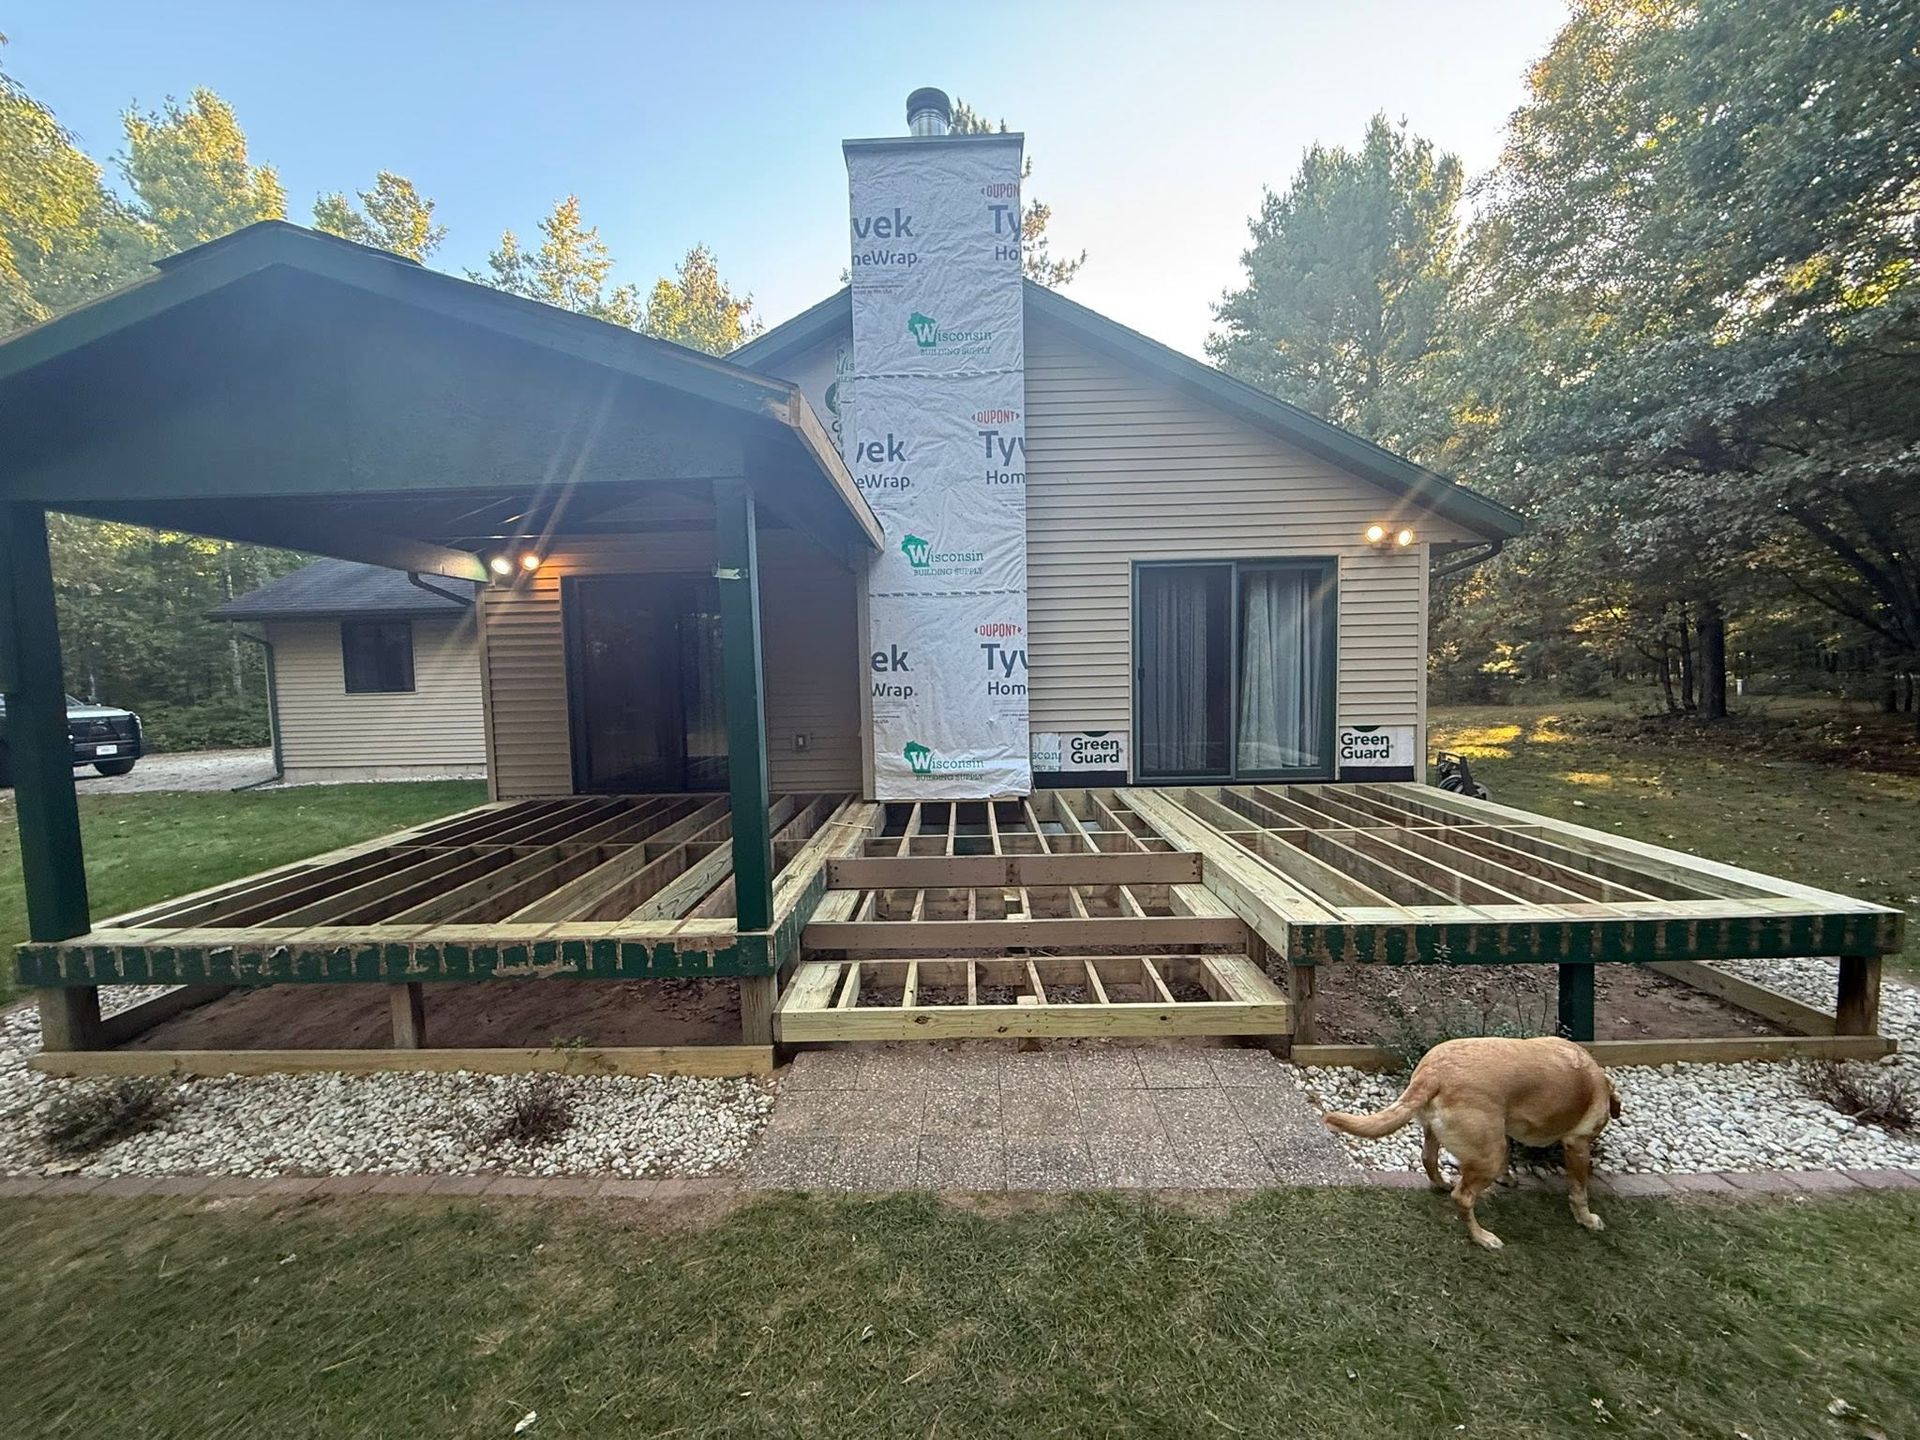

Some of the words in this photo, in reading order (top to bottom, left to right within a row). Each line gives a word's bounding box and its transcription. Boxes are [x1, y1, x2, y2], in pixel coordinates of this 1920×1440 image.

[987, 204, 1020, 242] Ty
[914, 322, 992, 343] Wisconsin
[977, 410, 1015, 424] DUPONT
[856, 474, 911, 492] eWrap
[908, 543, 984, 565] Wisconsin
[914, 568, 953, 576] BUILDING
[954, 567, 983, 575] SUPPLY
[980, 623, 1017, 637] DUPONT
[871, 644, 910, 672] ek
[1070, 737, 1119, 750] Green
[1341, 732, 1390, 746] Green
[1070, 750, 1120, 764] Guard
[1341, 746, 1390, 760] Guard
[910, 751, 984, 770] Wisconsin
[916, 773, 954, 781] BUILDING
[955, 773, 984, 781] SUPPLY
